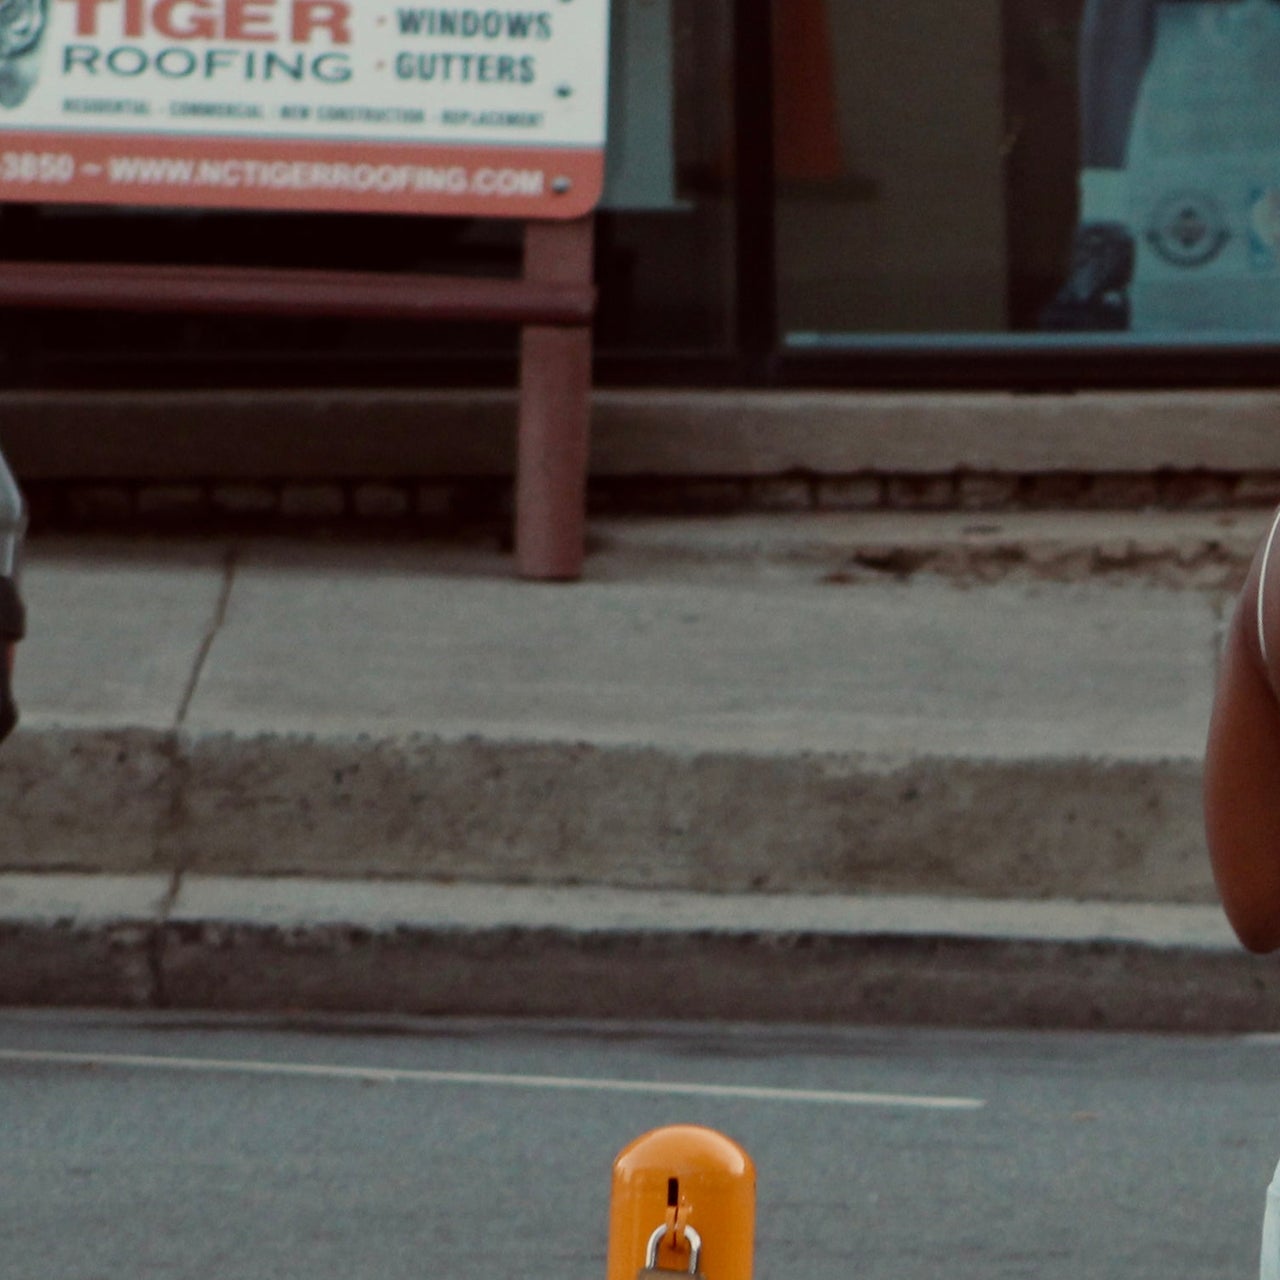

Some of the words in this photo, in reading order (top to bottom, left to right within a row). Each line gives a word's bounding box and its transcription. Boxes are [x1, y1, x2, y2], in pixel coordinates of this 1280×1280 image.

[56, 0, 352, 44] TIGER
[397, 8, 552, 40] WINDOWS
[62, 44, 353, 83] ROOFING
[395, 51, 536, 84] GUTTERS
[108, 156, 544, 196] WWW.NCTIGERROOFING.COM
